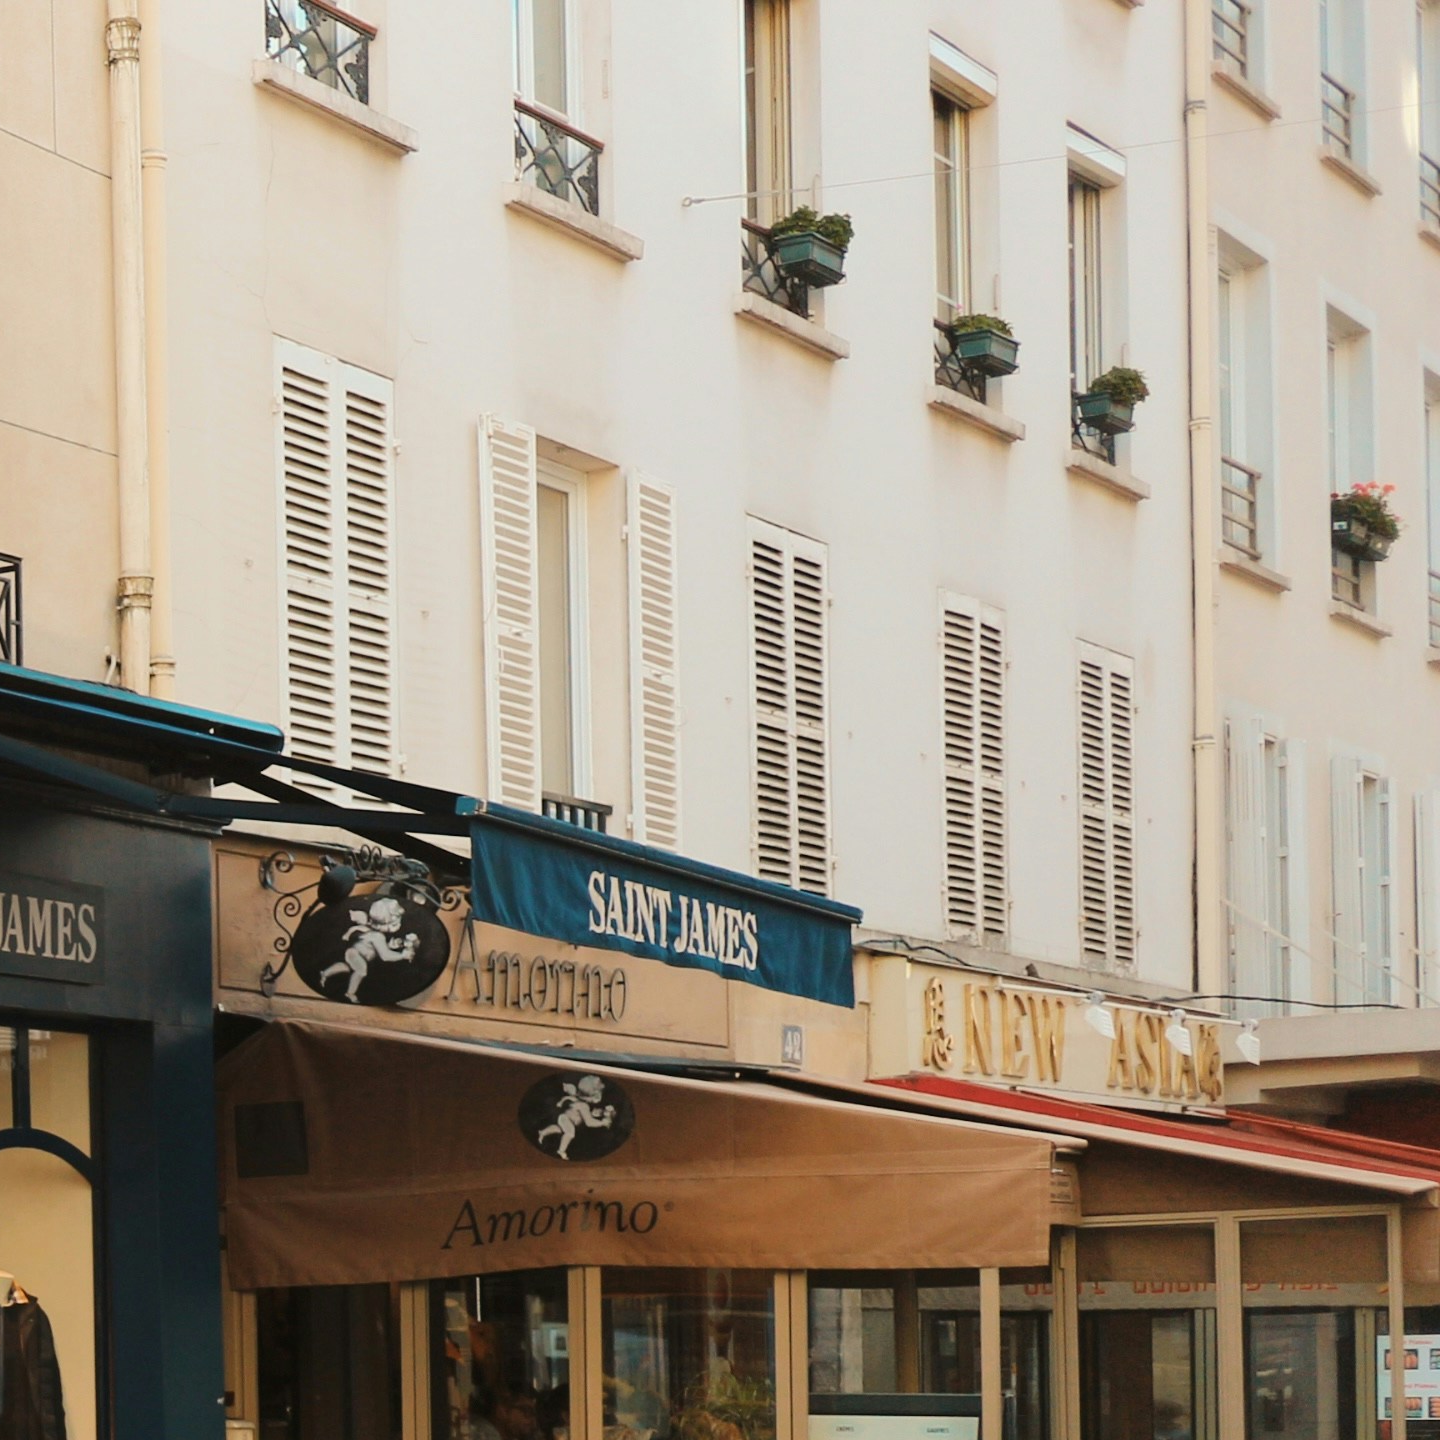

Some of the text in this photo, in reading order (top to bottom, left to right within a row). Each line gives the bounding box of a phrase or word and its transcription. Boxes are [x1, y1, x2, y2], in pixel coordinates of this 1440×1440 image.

[588, 871, 759, 972] SAINT JAMES
[784, 1031, 801, 1060] 42
[963, 983, 1066, 1083] NEW
[1107, 1007, 1201, 1100] ASIA
[440, 1188, 659, 1250] Amorino
